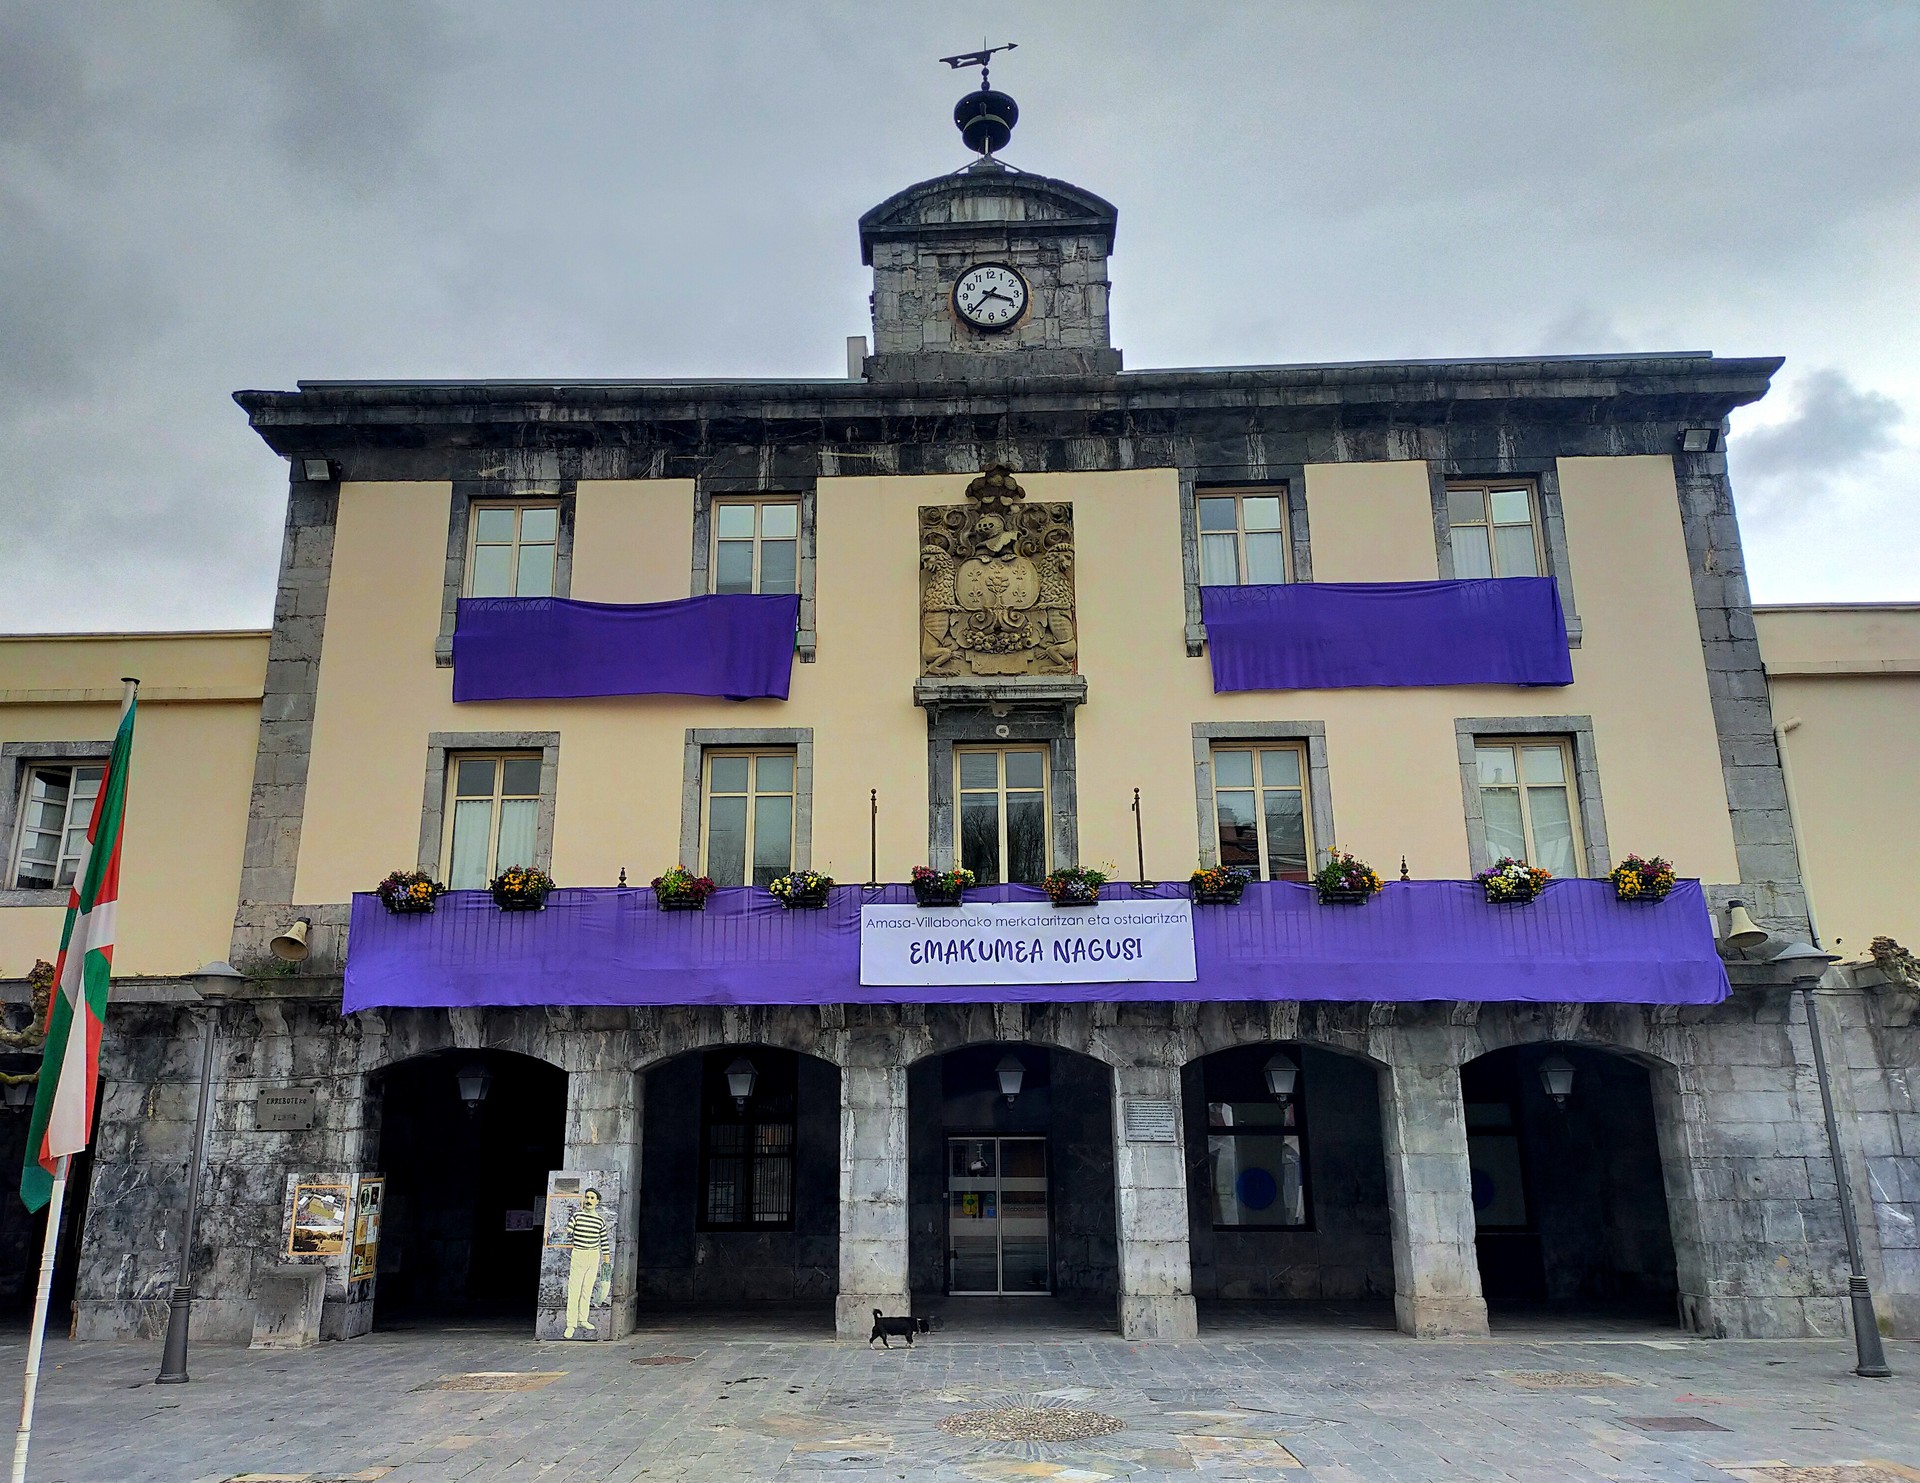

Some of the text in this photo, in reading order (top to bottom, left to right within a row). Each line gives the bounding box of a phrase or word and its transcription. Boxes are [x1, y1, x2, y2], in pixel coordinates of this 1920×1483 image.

[986, 271, 996, 279] 12
[966, 283, 976, 291] 10
[1008, 279, 1014, 287] 2
[1013, 290, 1019, 298] 3
[967, 303, 973, 311] 8
[976, 309, 982, 318] 7
[988, 312, 994, 320] 6
[1000, 308, 1007, 317] 5
[866, 913, 1188, 928] Amasa-Villabonako merkataritzan eta ostalaritzan
[910, 937, 1143, 965] EMAKUMEA NAGUSI
